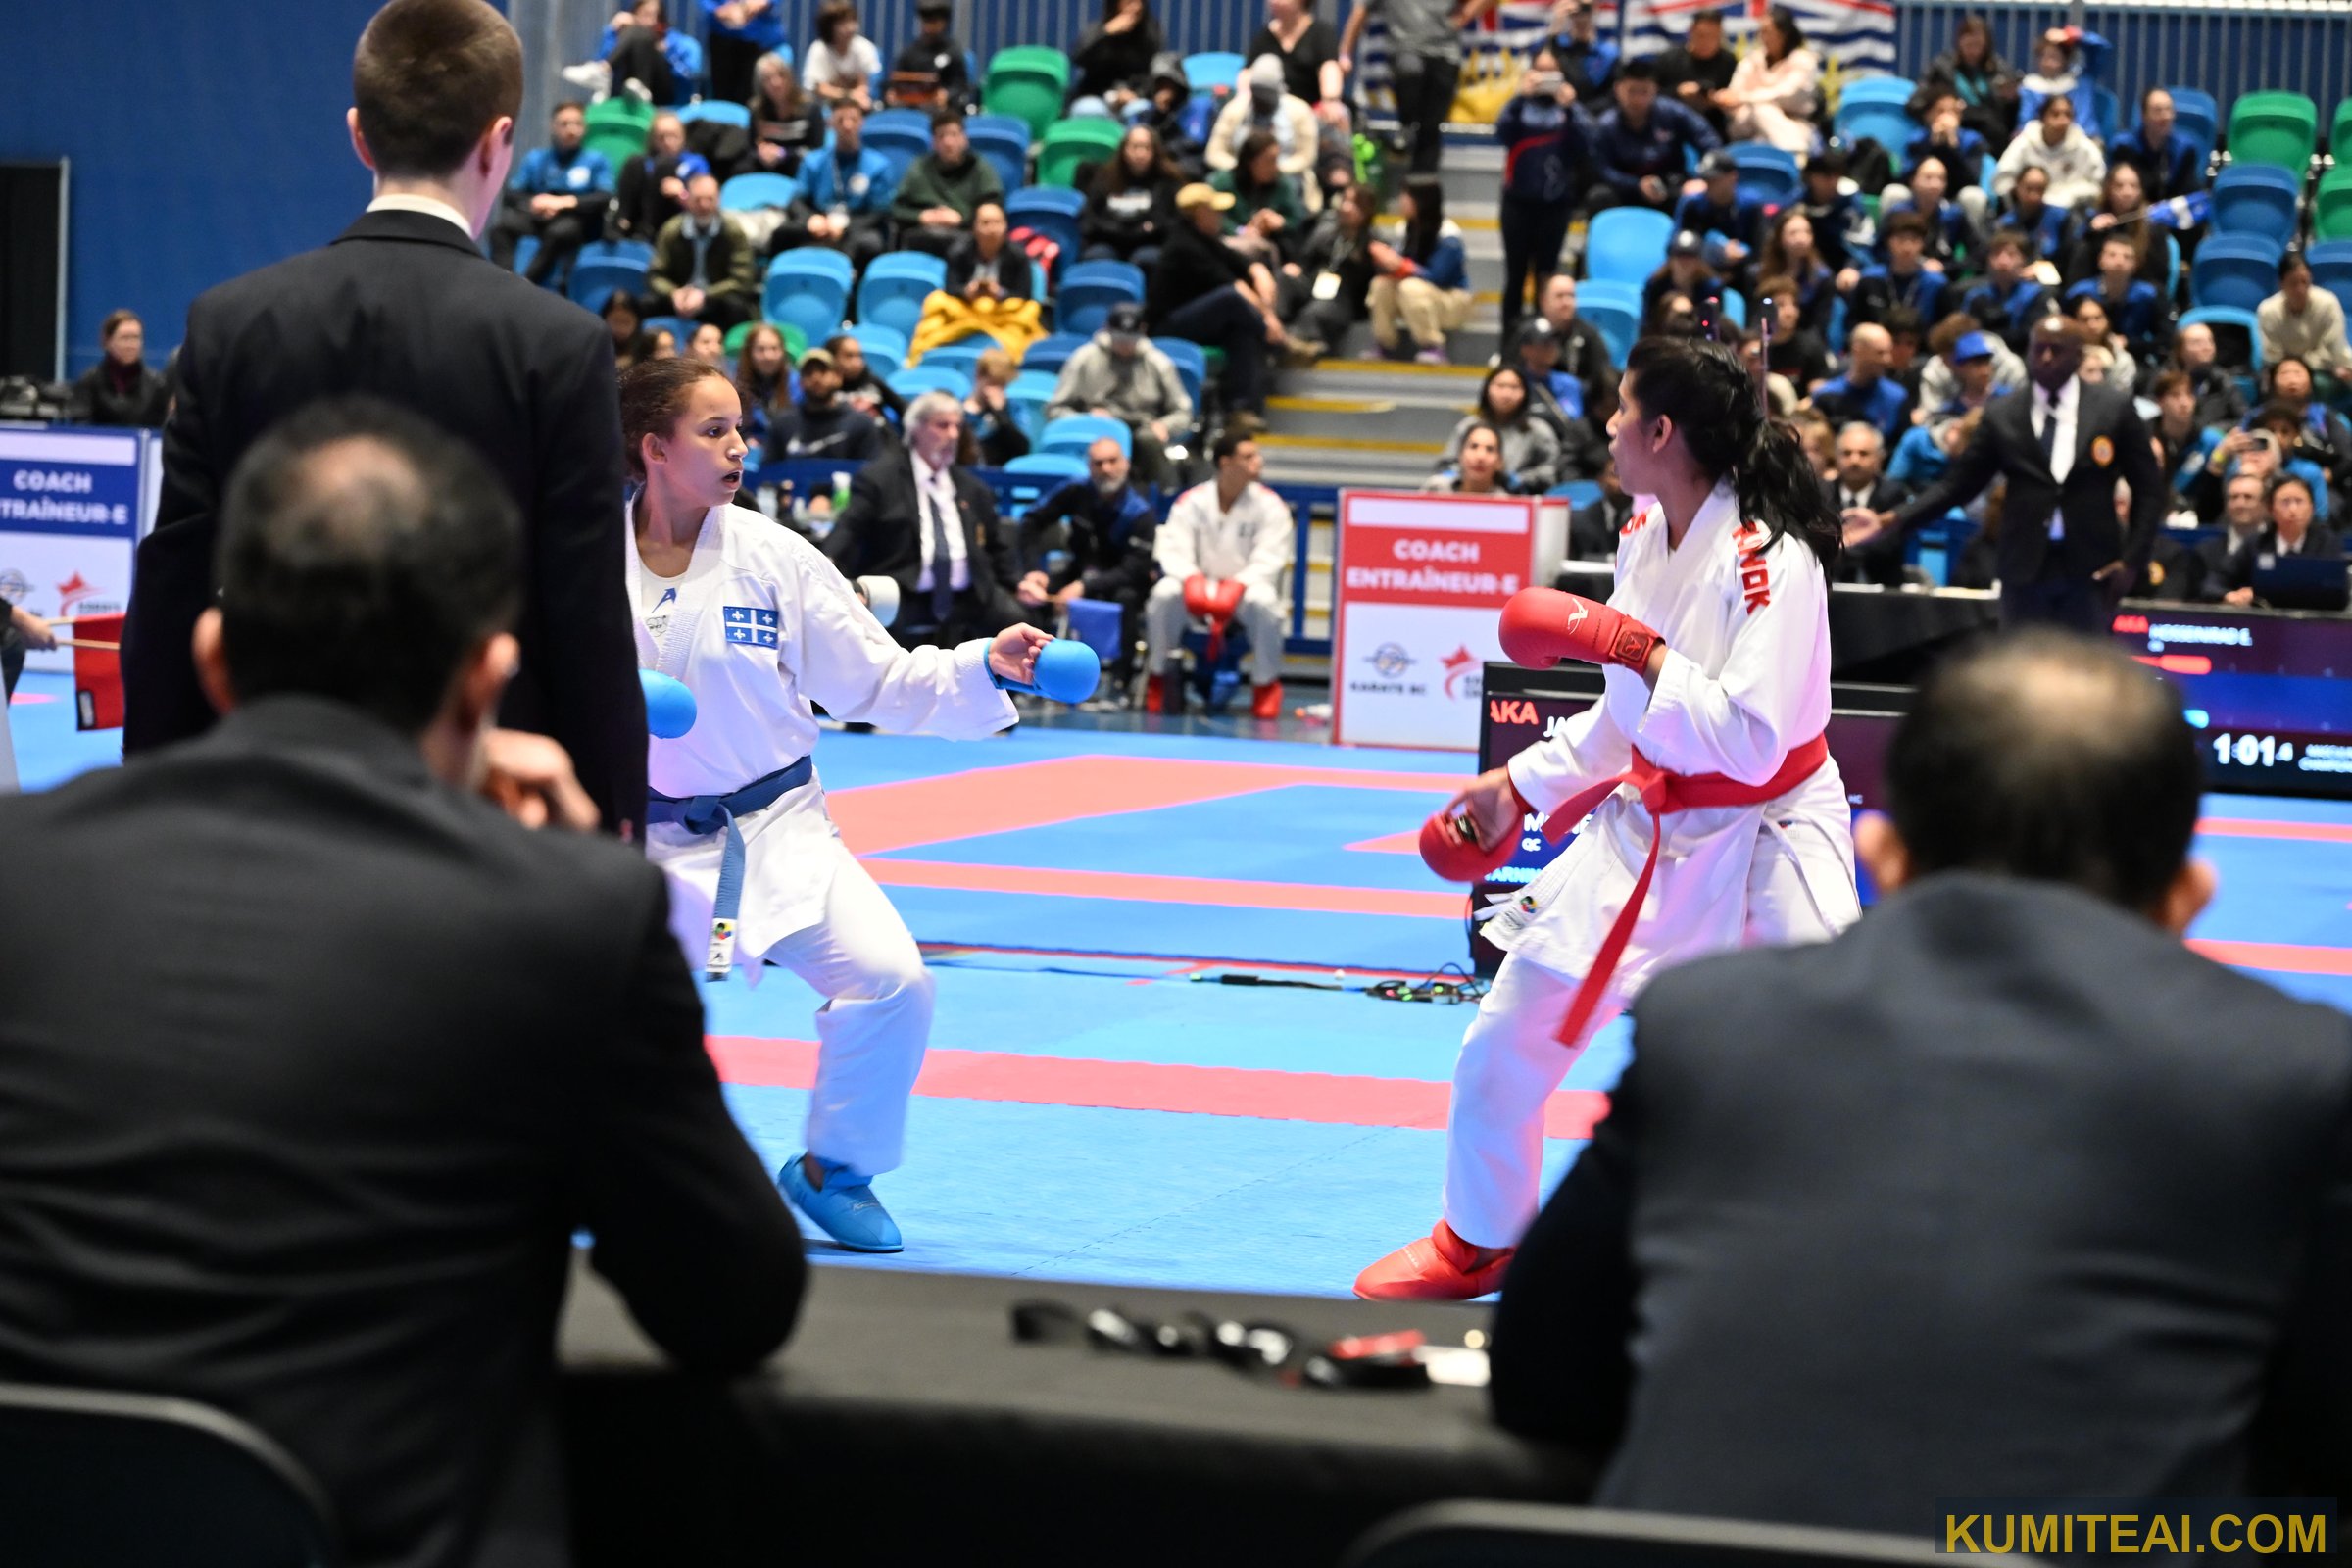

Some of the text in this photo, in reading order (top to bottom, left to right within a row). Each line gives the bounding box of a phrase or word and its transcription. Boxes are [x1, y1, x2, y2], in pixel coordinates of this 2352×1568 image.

[13, 469, 93, 494] COACH
[1393, 538, 1480, 563] COACH
[1490, 700, 1539, 724] AKA
[1521, 837, 1542, 852] QC
